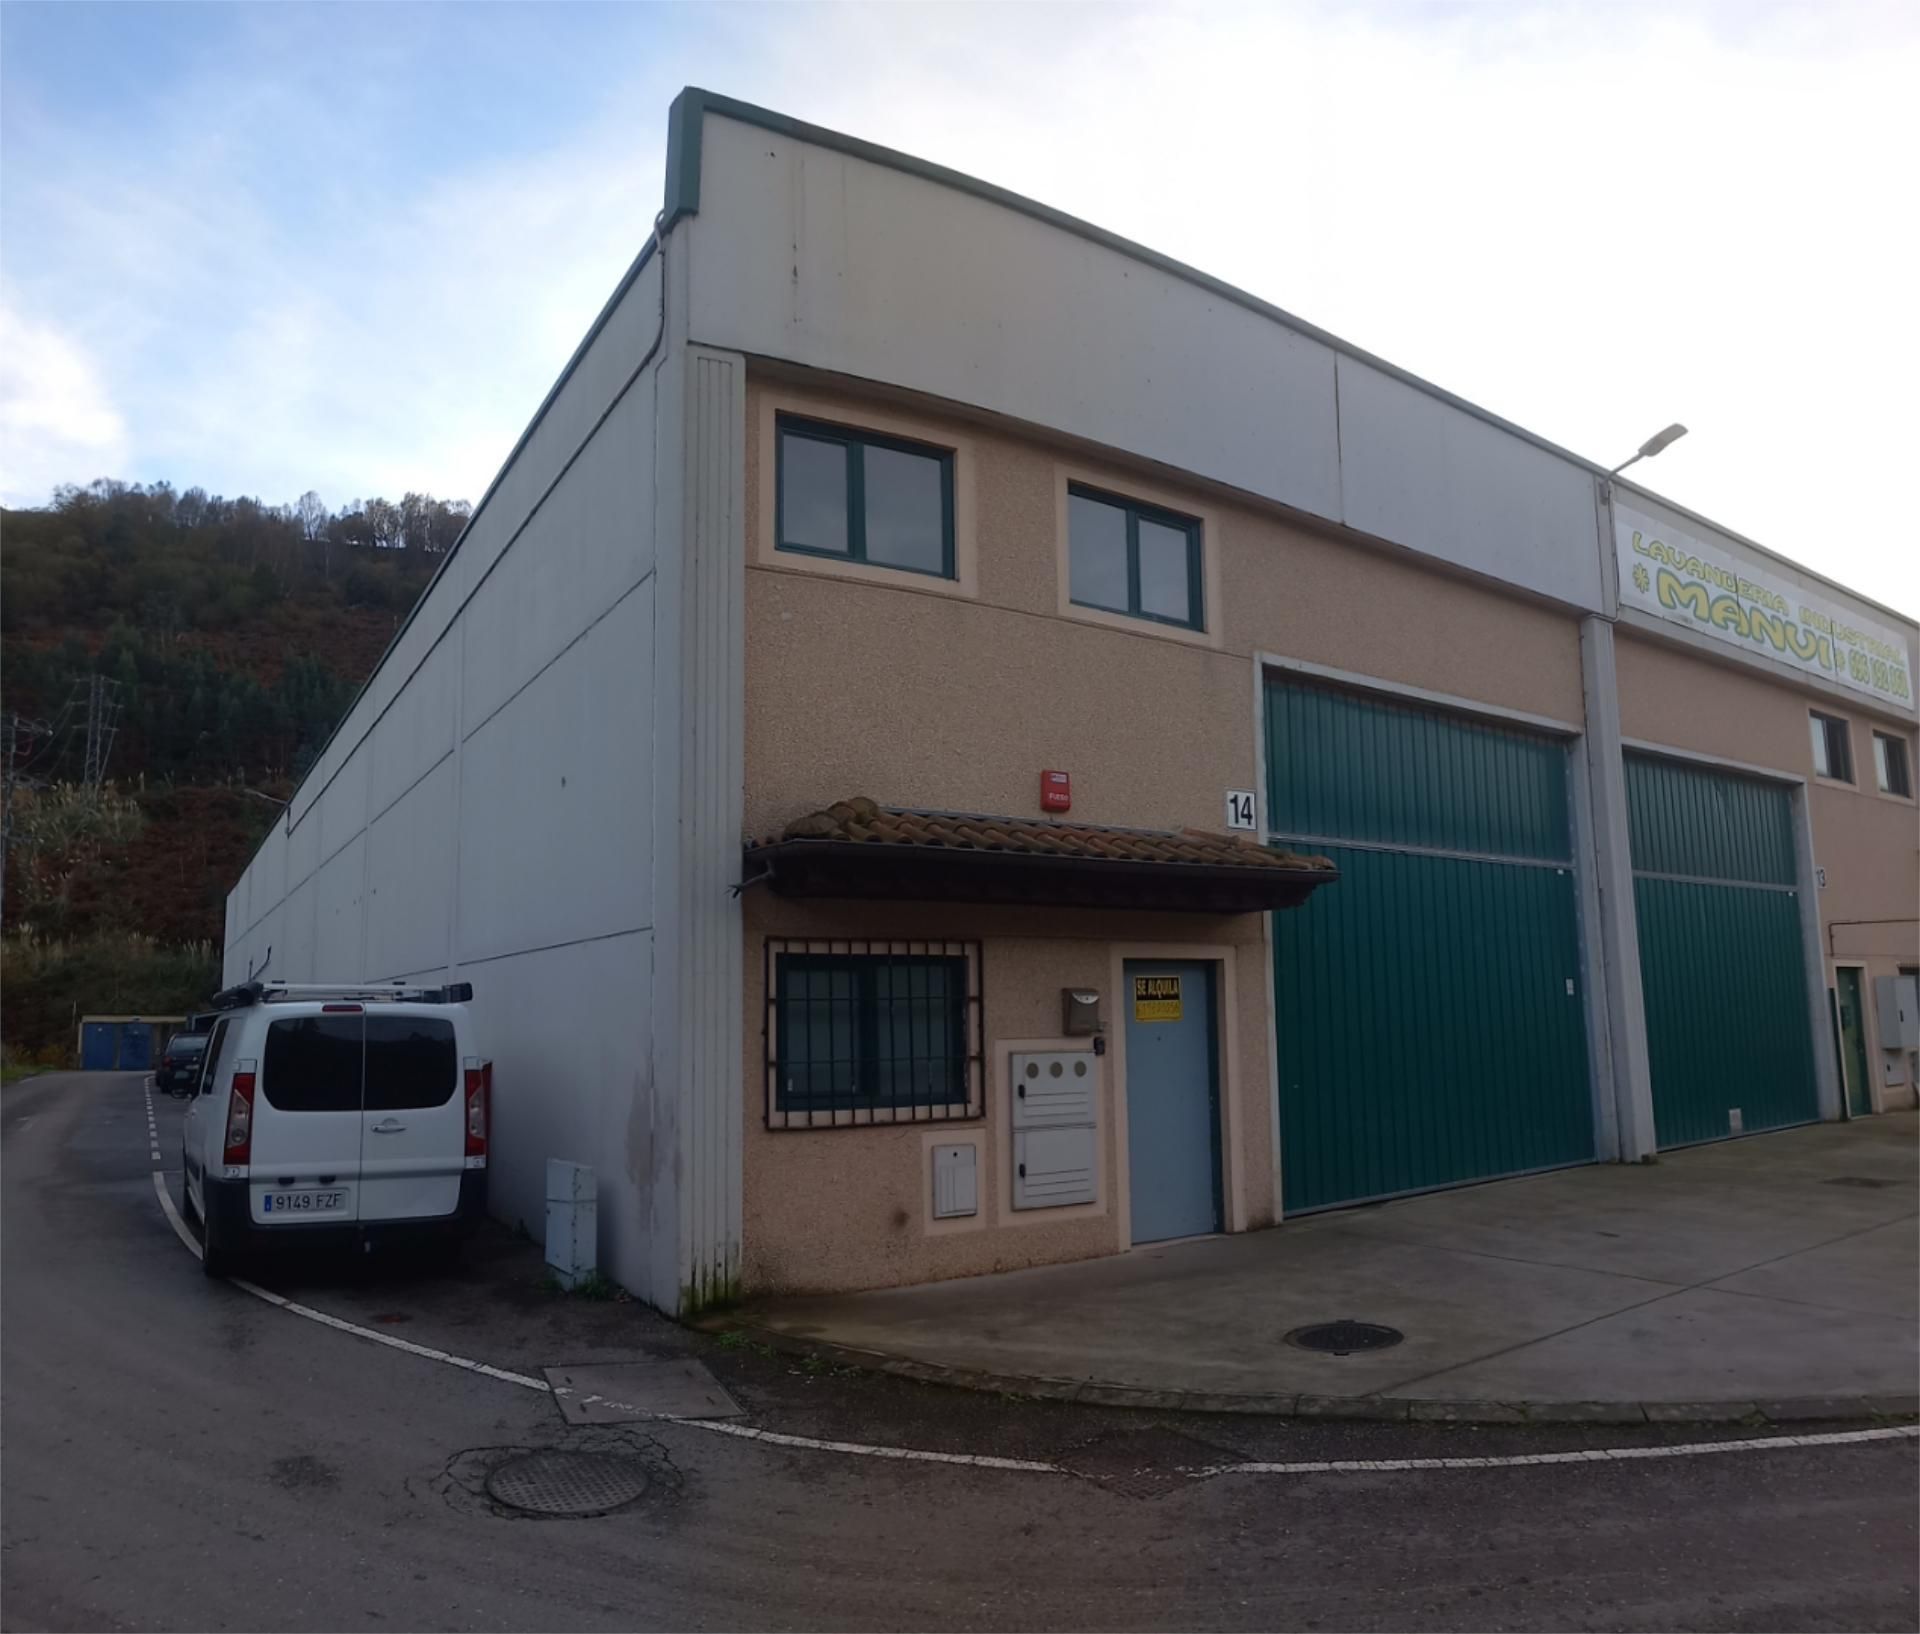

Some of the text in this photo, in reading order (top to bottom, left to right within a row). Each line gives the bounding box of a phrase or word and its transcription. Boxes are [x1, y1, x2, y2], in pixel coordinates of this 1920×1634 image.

[1632, 531, 1789, 616] LAVANDERIA
[1229, 794, 1253, 825] 14
[1816, 868, 1826, 888] 13
[1136, 979, 1178, 999] SE ALQUILA
[276, 1193, 343, 1210] 9149 FZF
